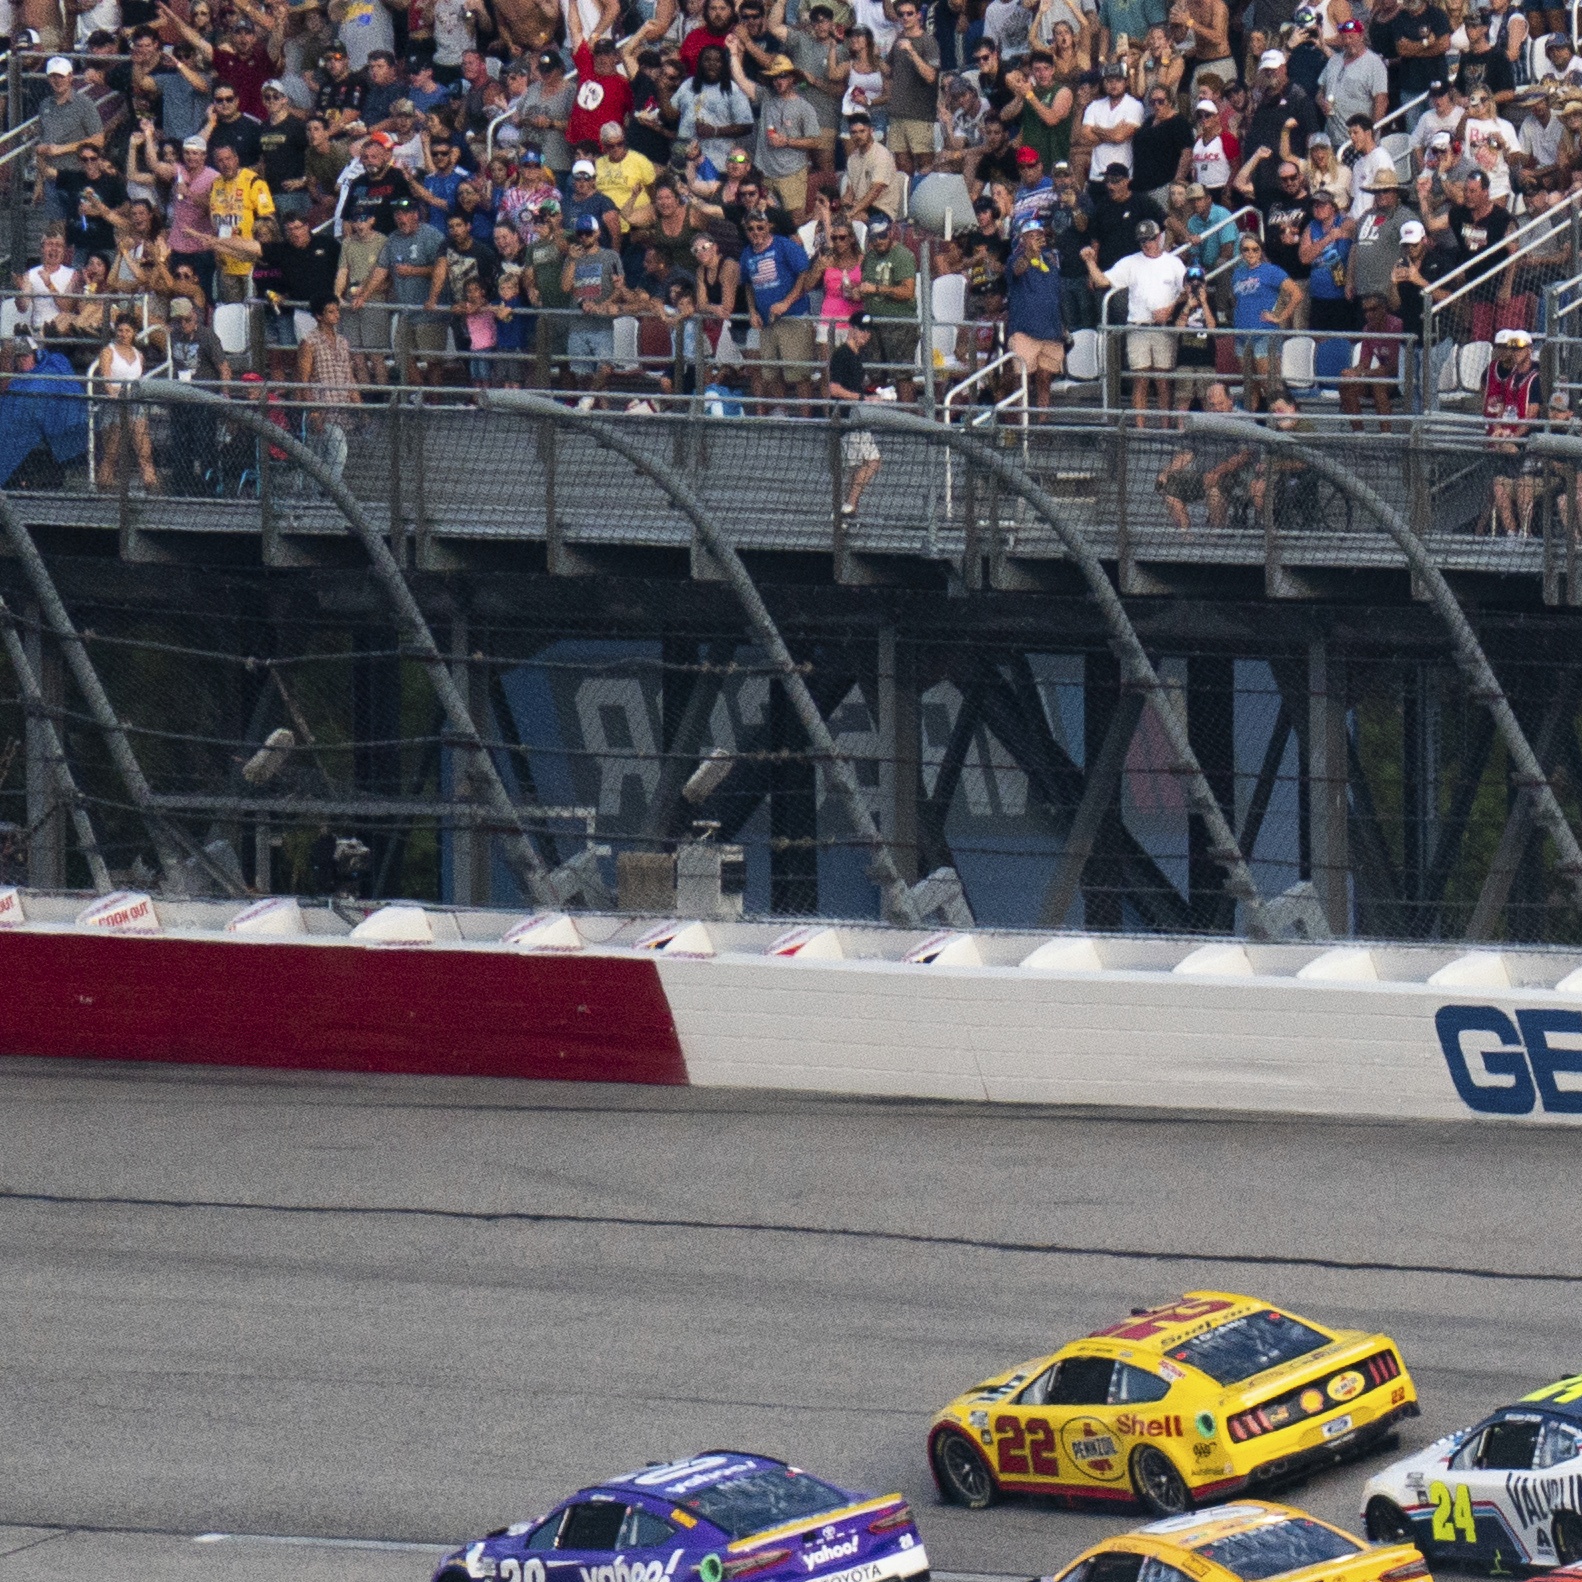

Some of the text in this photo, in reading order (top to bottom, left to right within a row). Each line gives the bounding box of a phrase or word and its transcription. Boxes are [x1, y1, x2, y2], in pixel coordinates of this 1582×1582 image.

[1391, 1387, 1406, 1405] 22
[1116, 1412, 1184, 1438] Shell
[995, 1415, 1059, 1477] 22
[1429, 1479, 1477, 1544] 24
[802, 1535, 859, 1572] yahoo!
